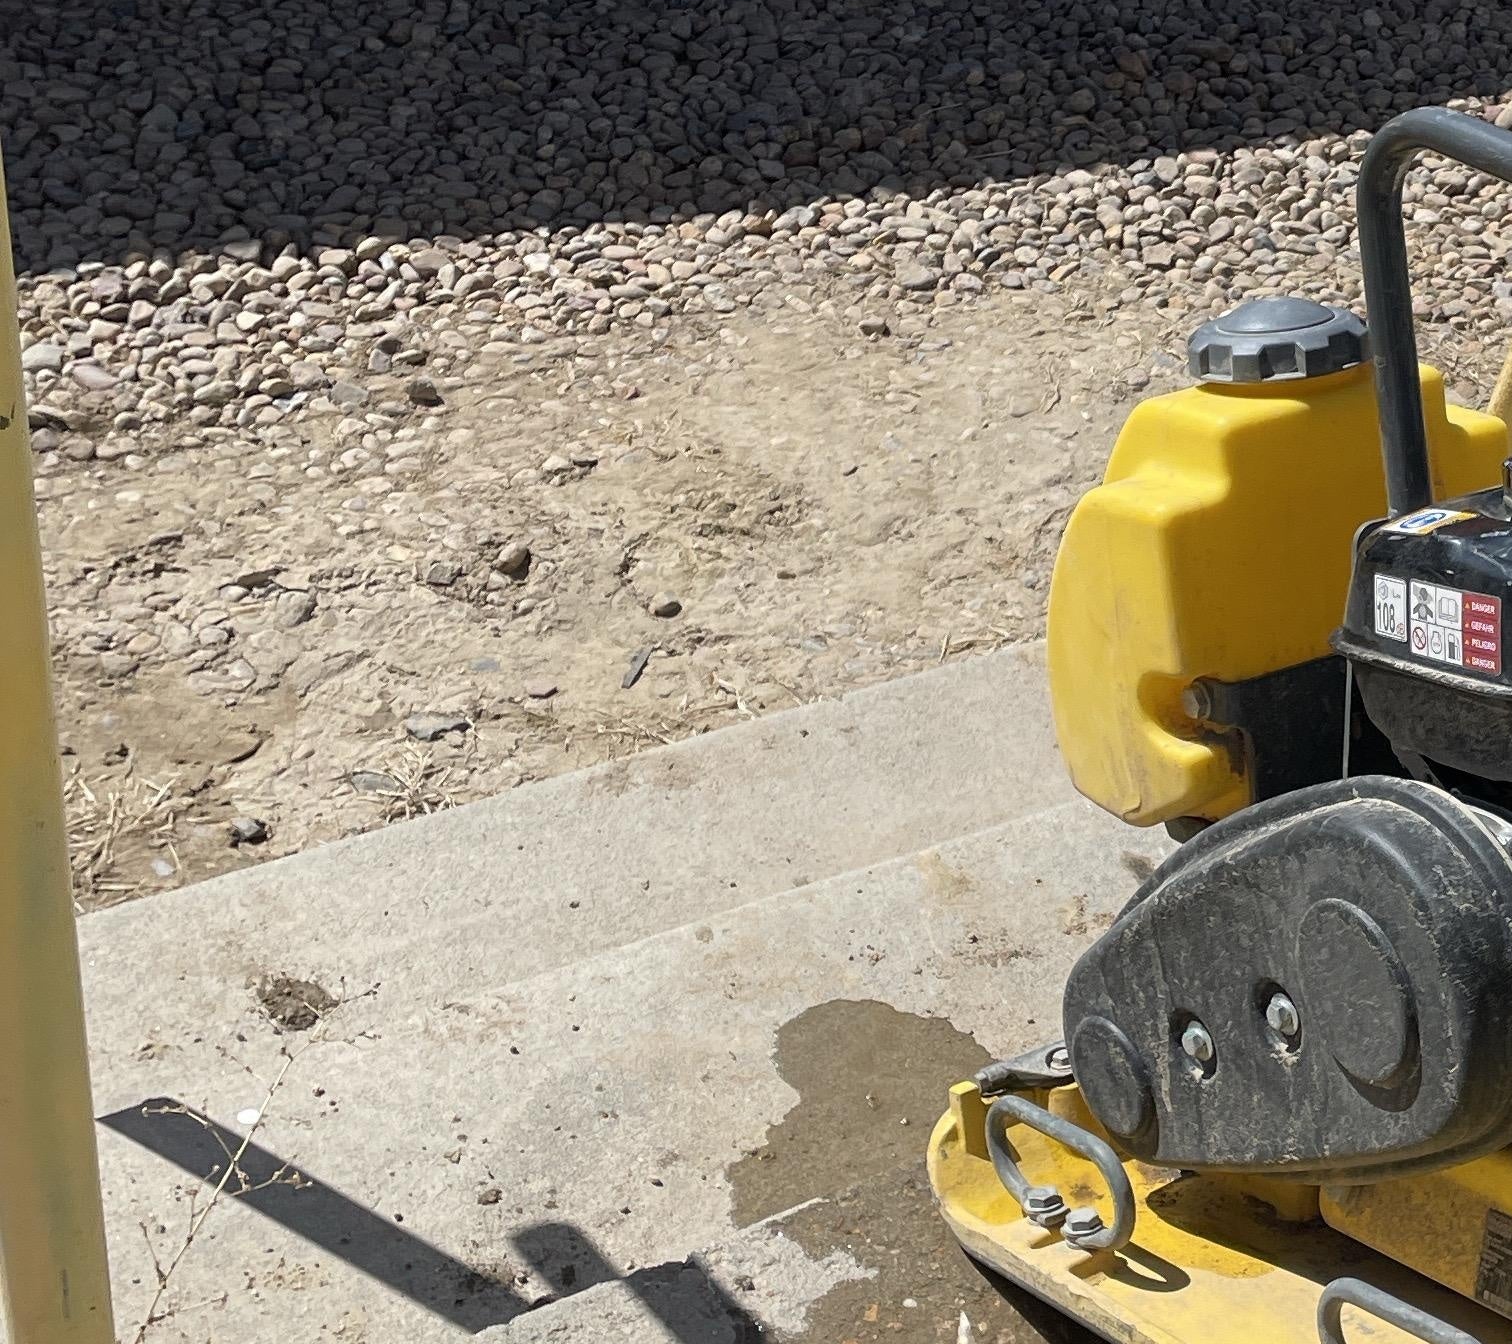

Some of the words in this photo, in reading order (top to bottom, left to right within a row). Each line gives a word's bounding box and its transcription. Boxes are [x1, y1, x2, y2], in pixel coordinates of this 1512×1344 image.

[1471, 601, 1496, 615] DANGER
[1377, 601, 1396, 634] 108
[1470, 620, 1495, 634] GEFAHR
[1471, 638, 1497, 652] PELIGRO
[1471, 657, 1496, 670] DANGER
